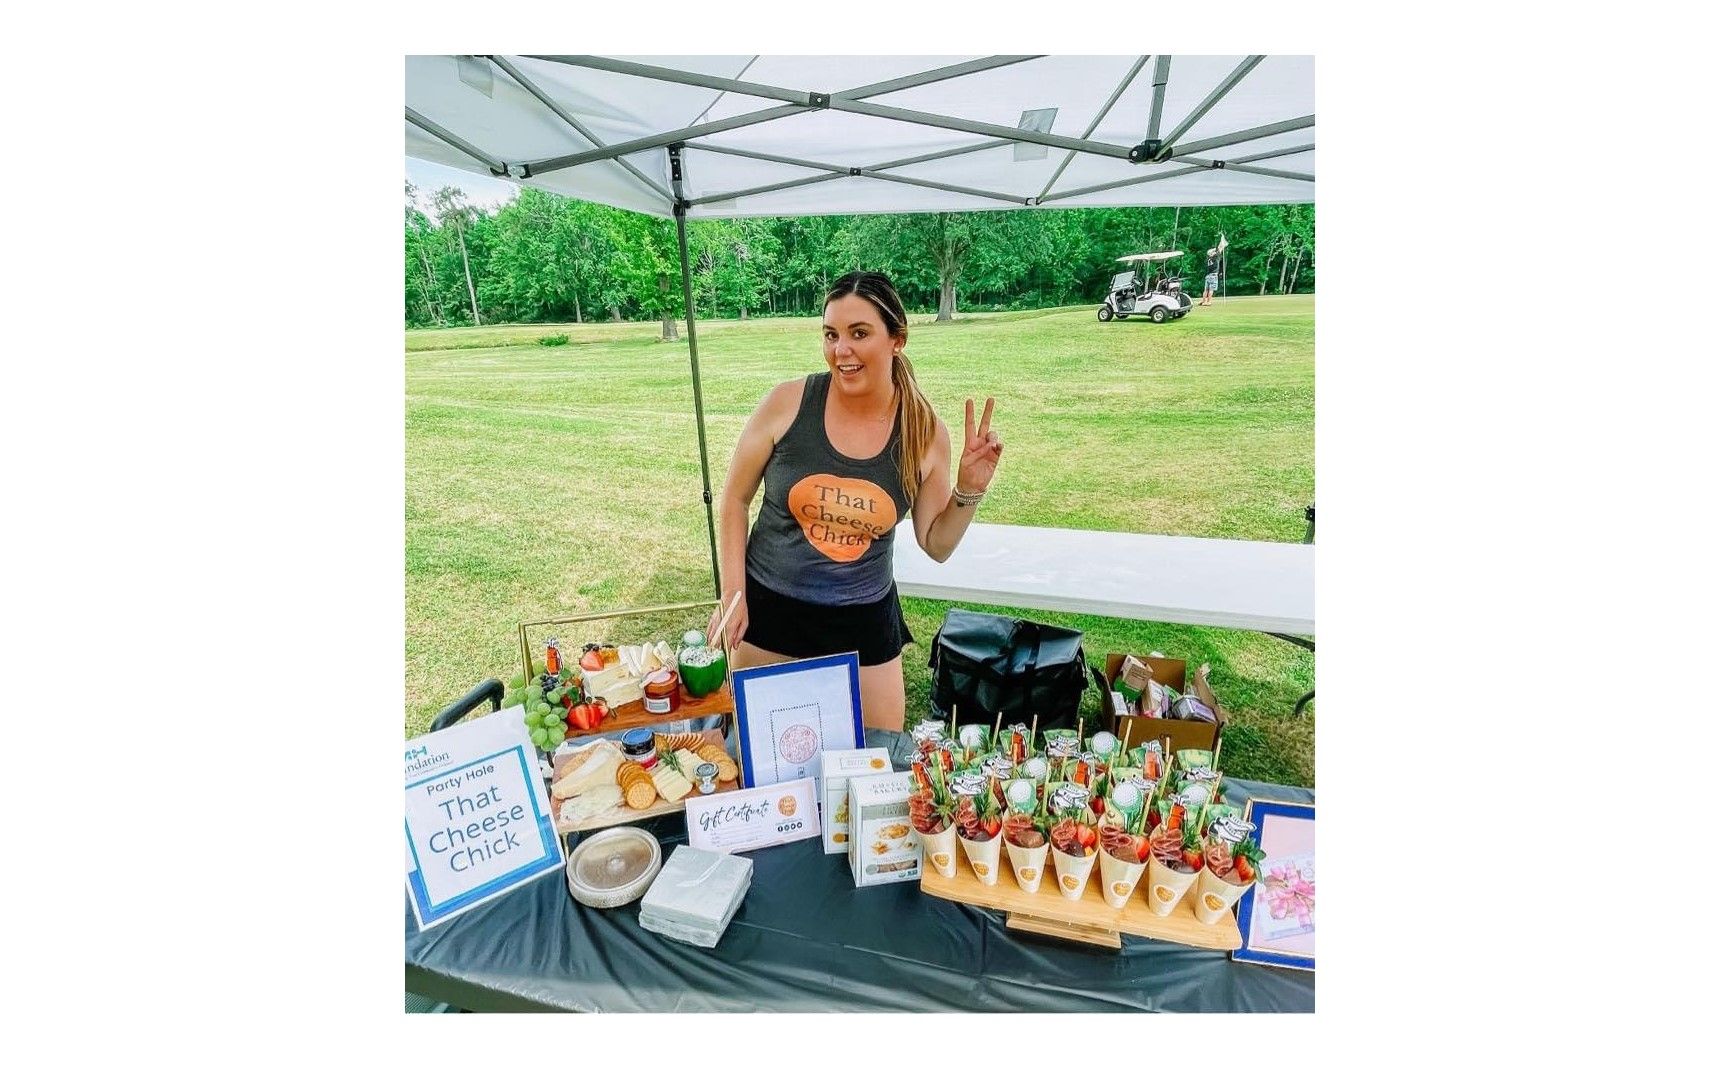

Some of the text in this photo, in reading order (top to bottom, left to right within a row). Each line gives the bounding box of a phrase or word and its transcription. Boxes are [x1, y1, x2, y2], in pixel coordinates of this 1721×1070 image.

[815, 485, 877, 513] That
[801, 504, 883, 535] Cheese
[810, 523, 866, 546] Chick
[426, 777, 461, 796] Party
[466, 764, 494, 780] Hole
[438, 785, 502, 820] That
[429, 805, 524, 853] Cheese
[699, 807, 725, 832] Gift
[450, 831, 520, 872] Chick
